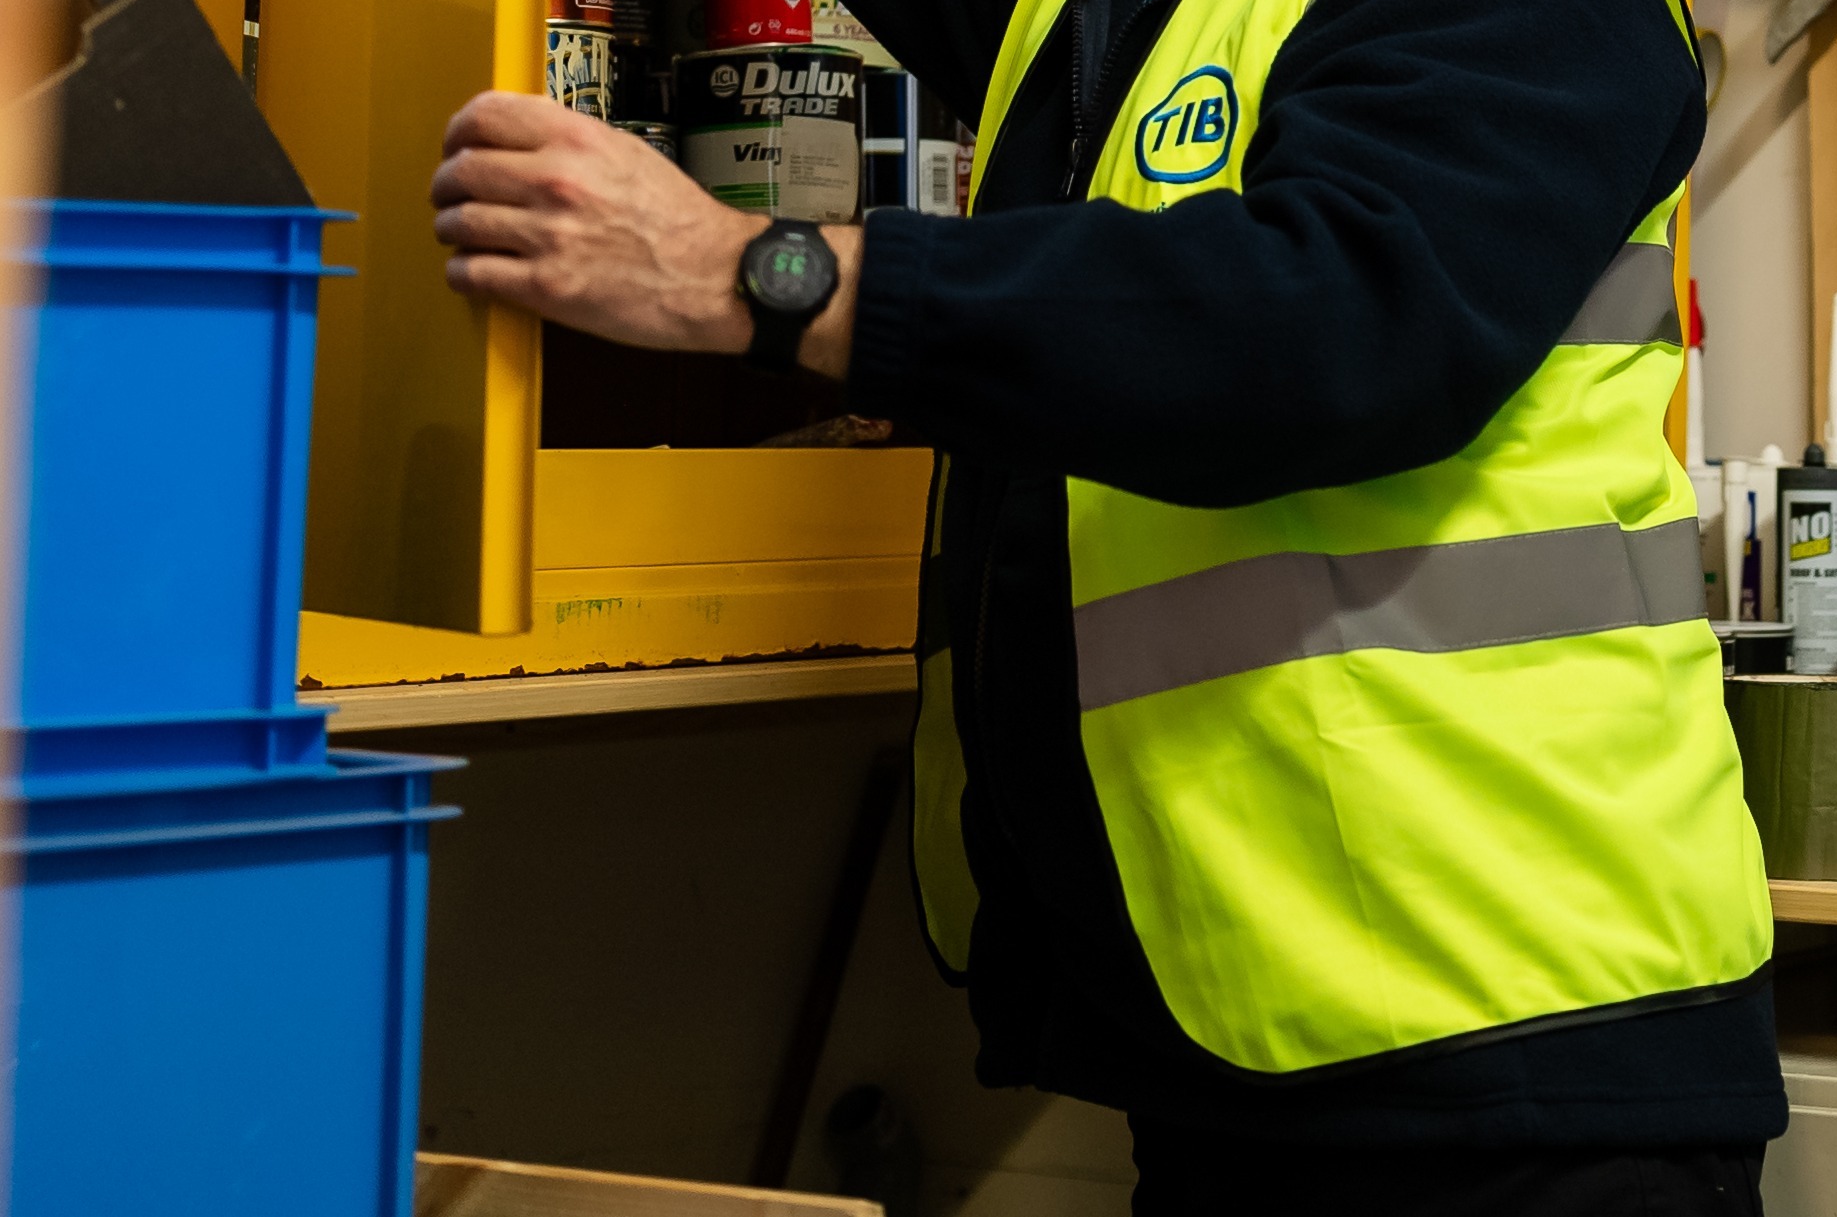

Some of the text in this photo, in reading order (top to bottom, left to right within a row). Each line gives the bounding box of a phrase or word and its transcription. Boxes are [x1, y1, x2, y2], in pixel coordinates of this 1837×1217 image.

[715, 61, 855, 98] ICI Dulux
[740, 97, 839, 115] TRADE
[1152, 97, 1225, 153] TIB
[1790, 511, 1831, 544] NO
